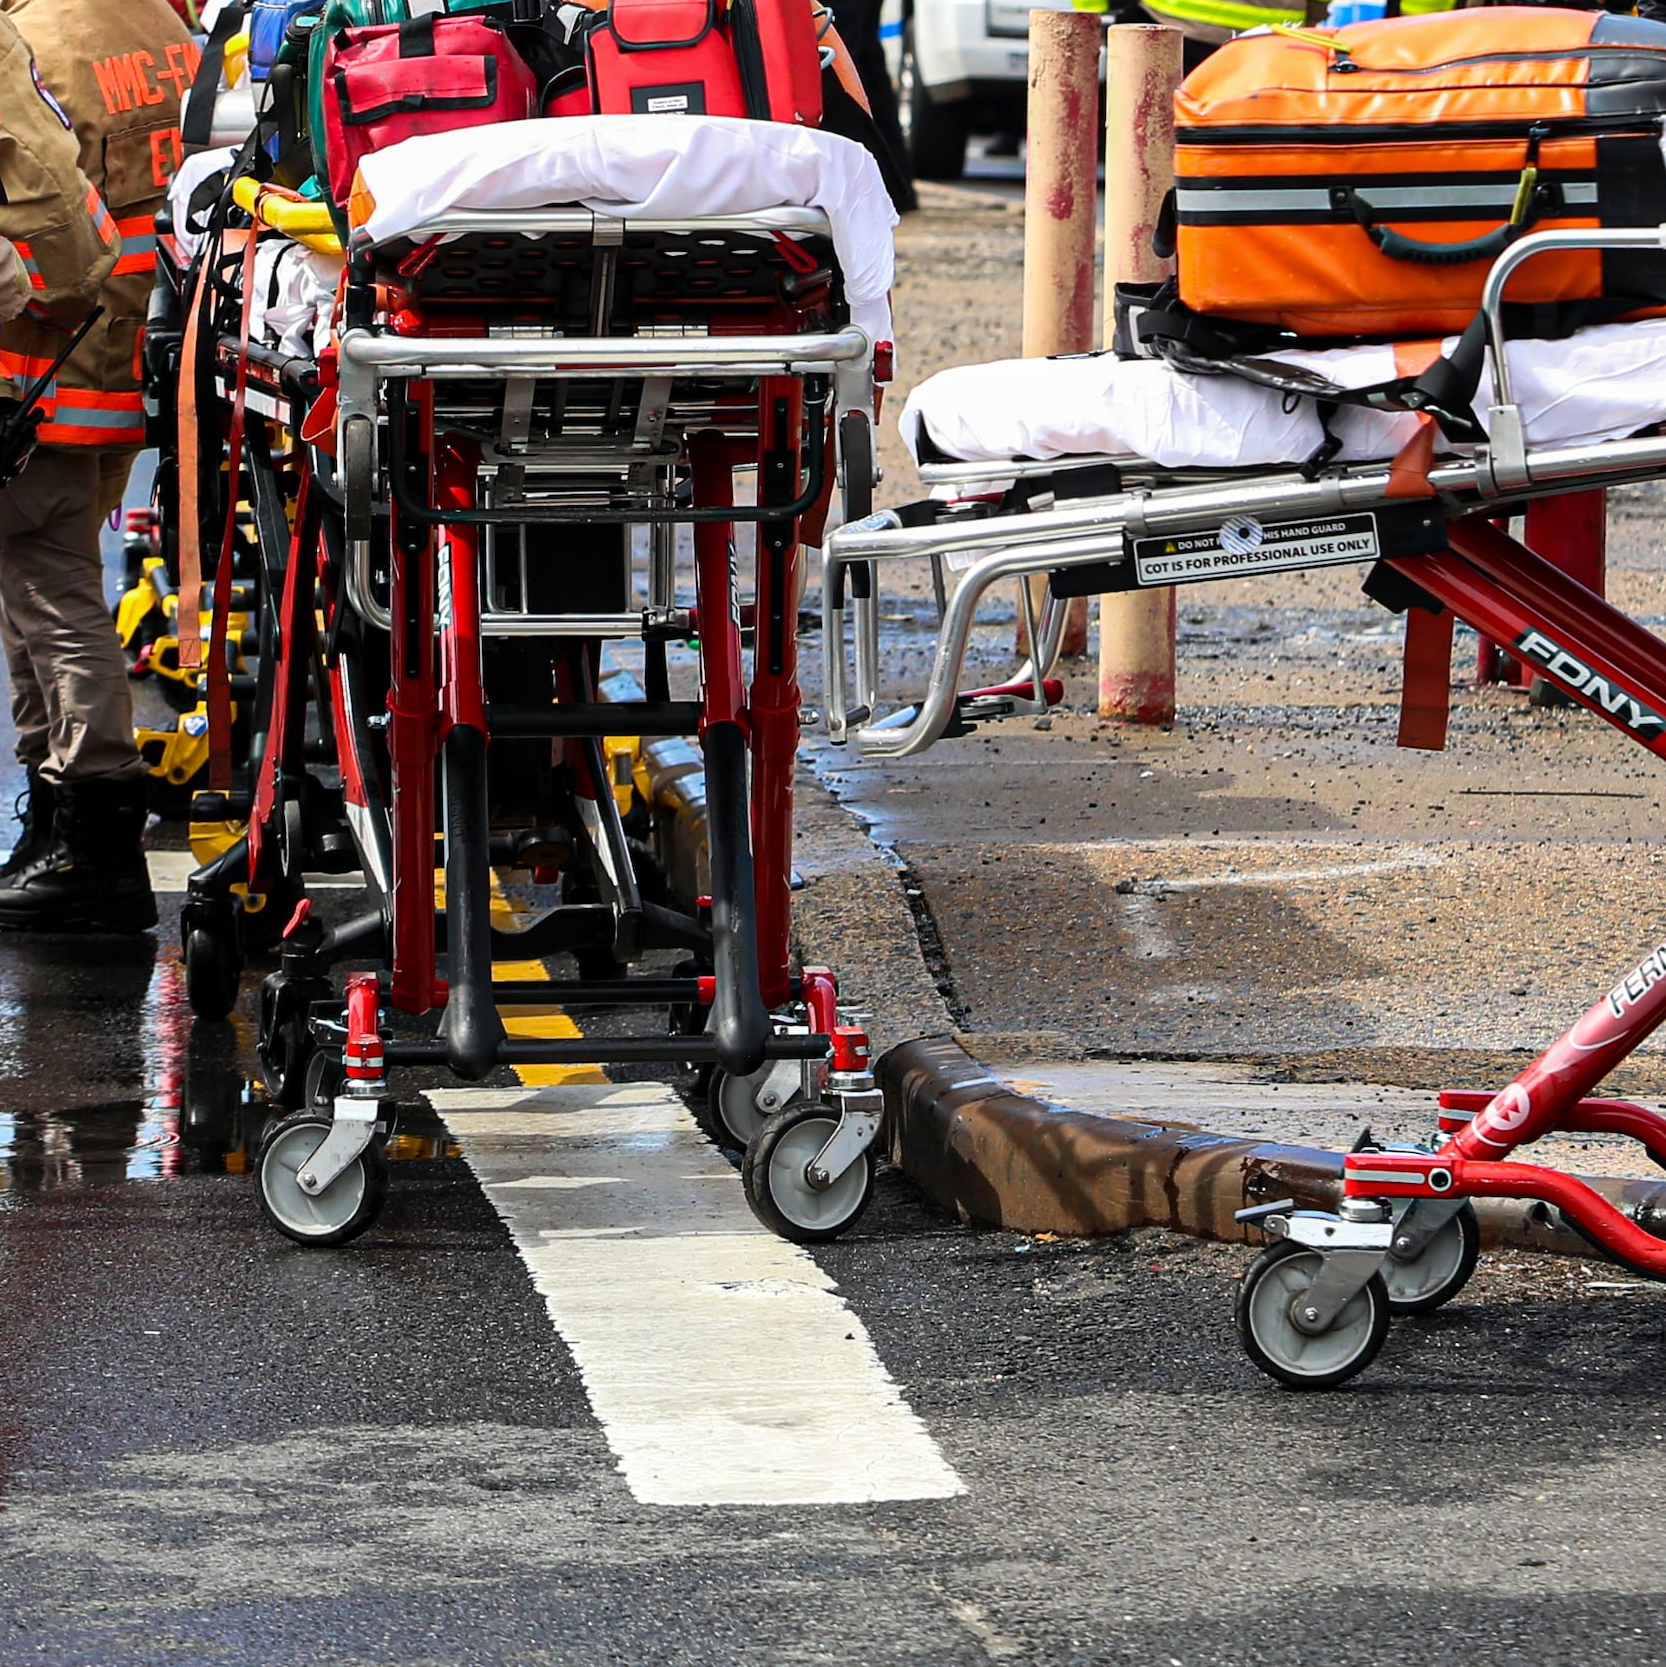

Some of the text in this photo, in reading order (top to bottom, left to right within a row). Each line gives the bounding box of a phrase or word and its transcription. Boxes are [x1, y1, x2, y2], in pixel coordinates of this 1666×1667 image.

[1178, 540, 1194, 551] DO
[1194, 538, 1216, 549] NOT
[1261, 529, 1280, 540] HIS
[1280, 526, 1310, 539] HAND
[1311, 521, 1347, 535] GUARD
[1144, 537, 1371, 575] COT IS FOR PROFESSIONAL USE ONLY
[1518, 631, 1664, 730] FDNY
